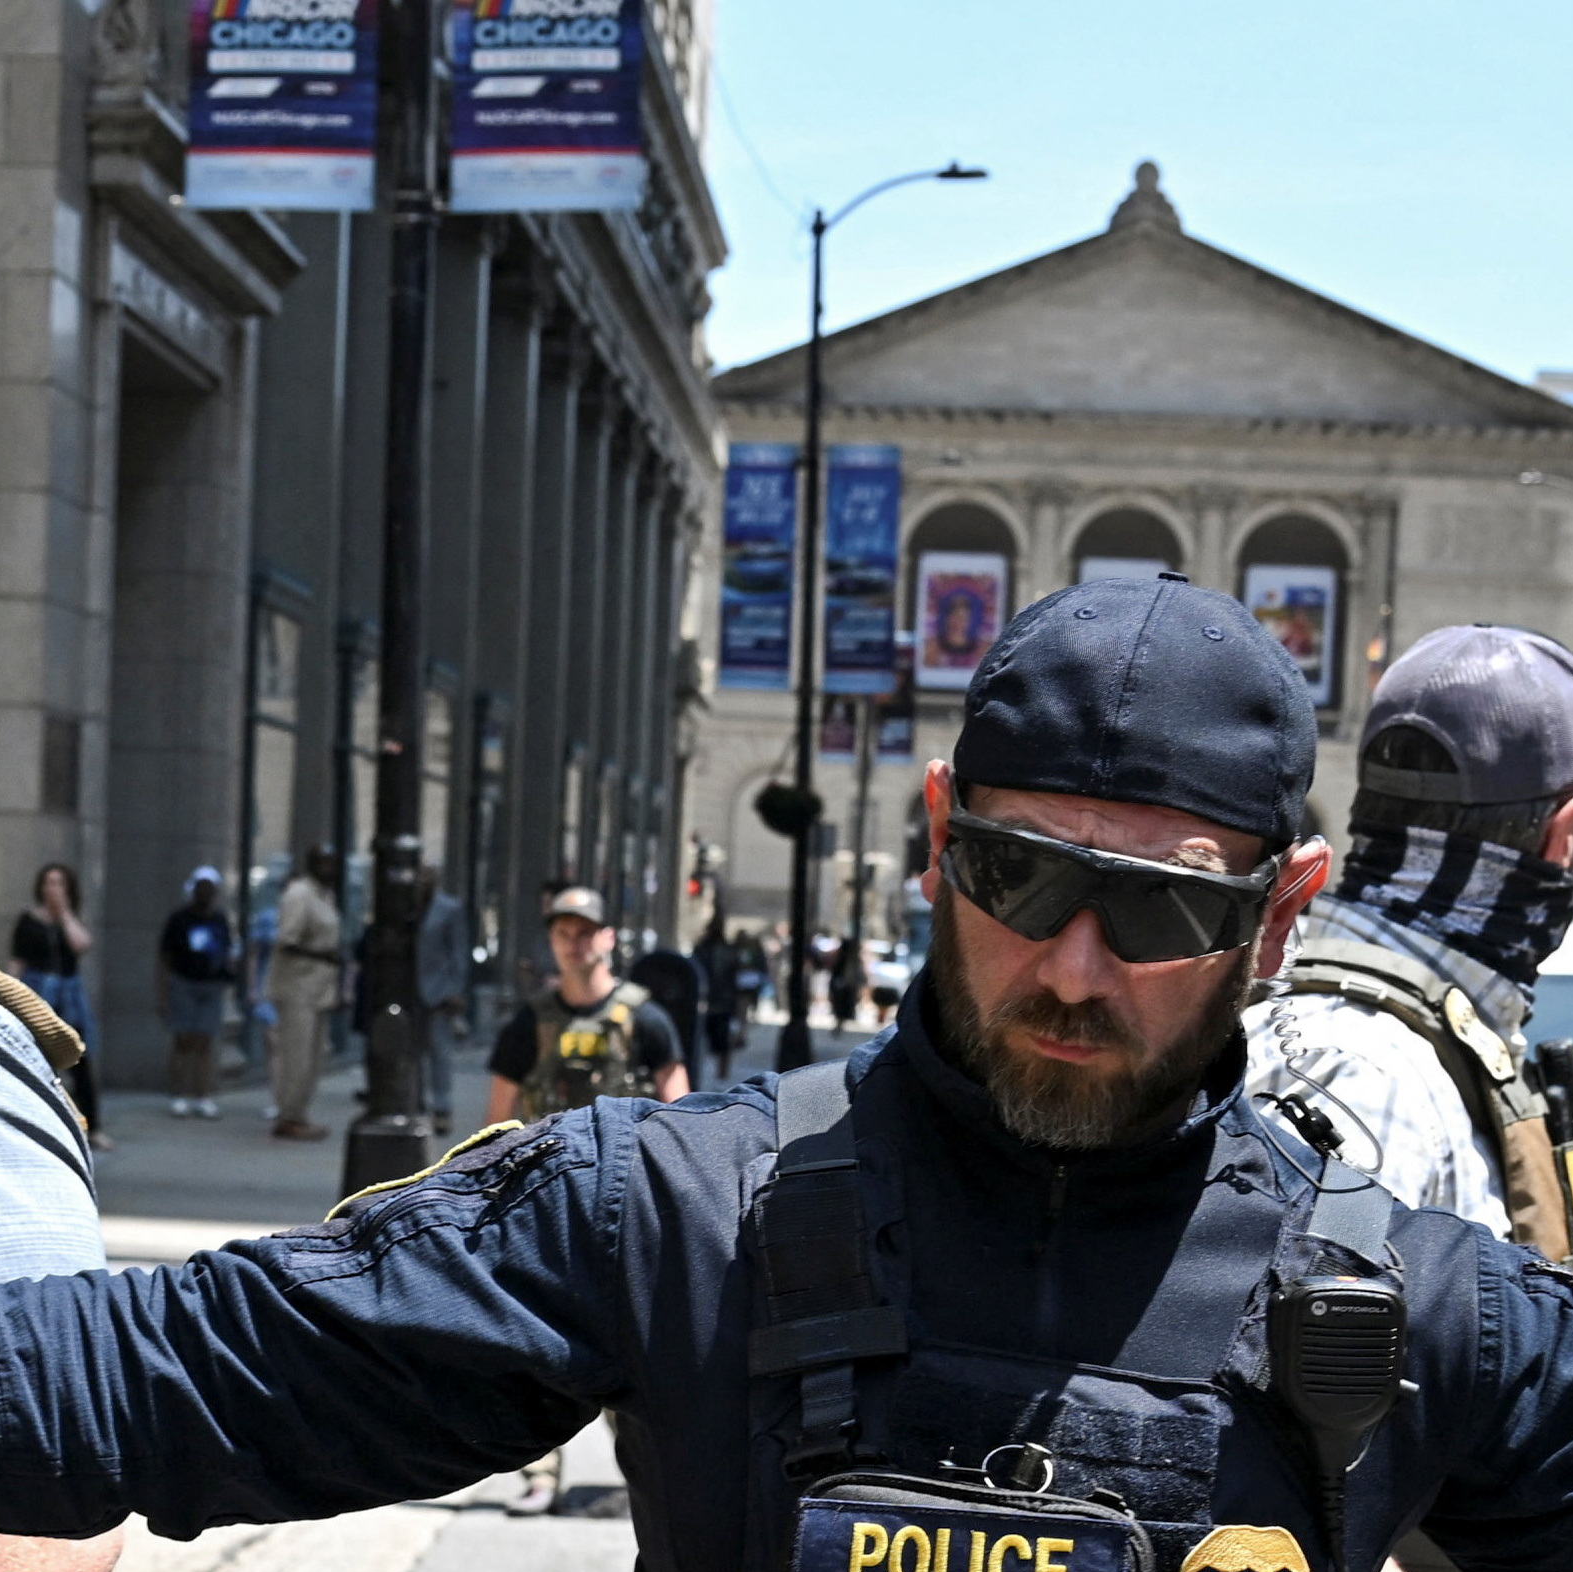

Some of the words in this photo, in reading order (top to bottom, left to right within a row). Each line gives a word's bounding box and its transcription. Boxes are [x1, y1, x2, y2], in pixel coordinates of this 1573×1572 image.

[210, 20, 356, 47] CHICAGO
[475, 18, 620, 46] CHICAGO
[1330, 1305, 1389, 1314] MOTOROLA
